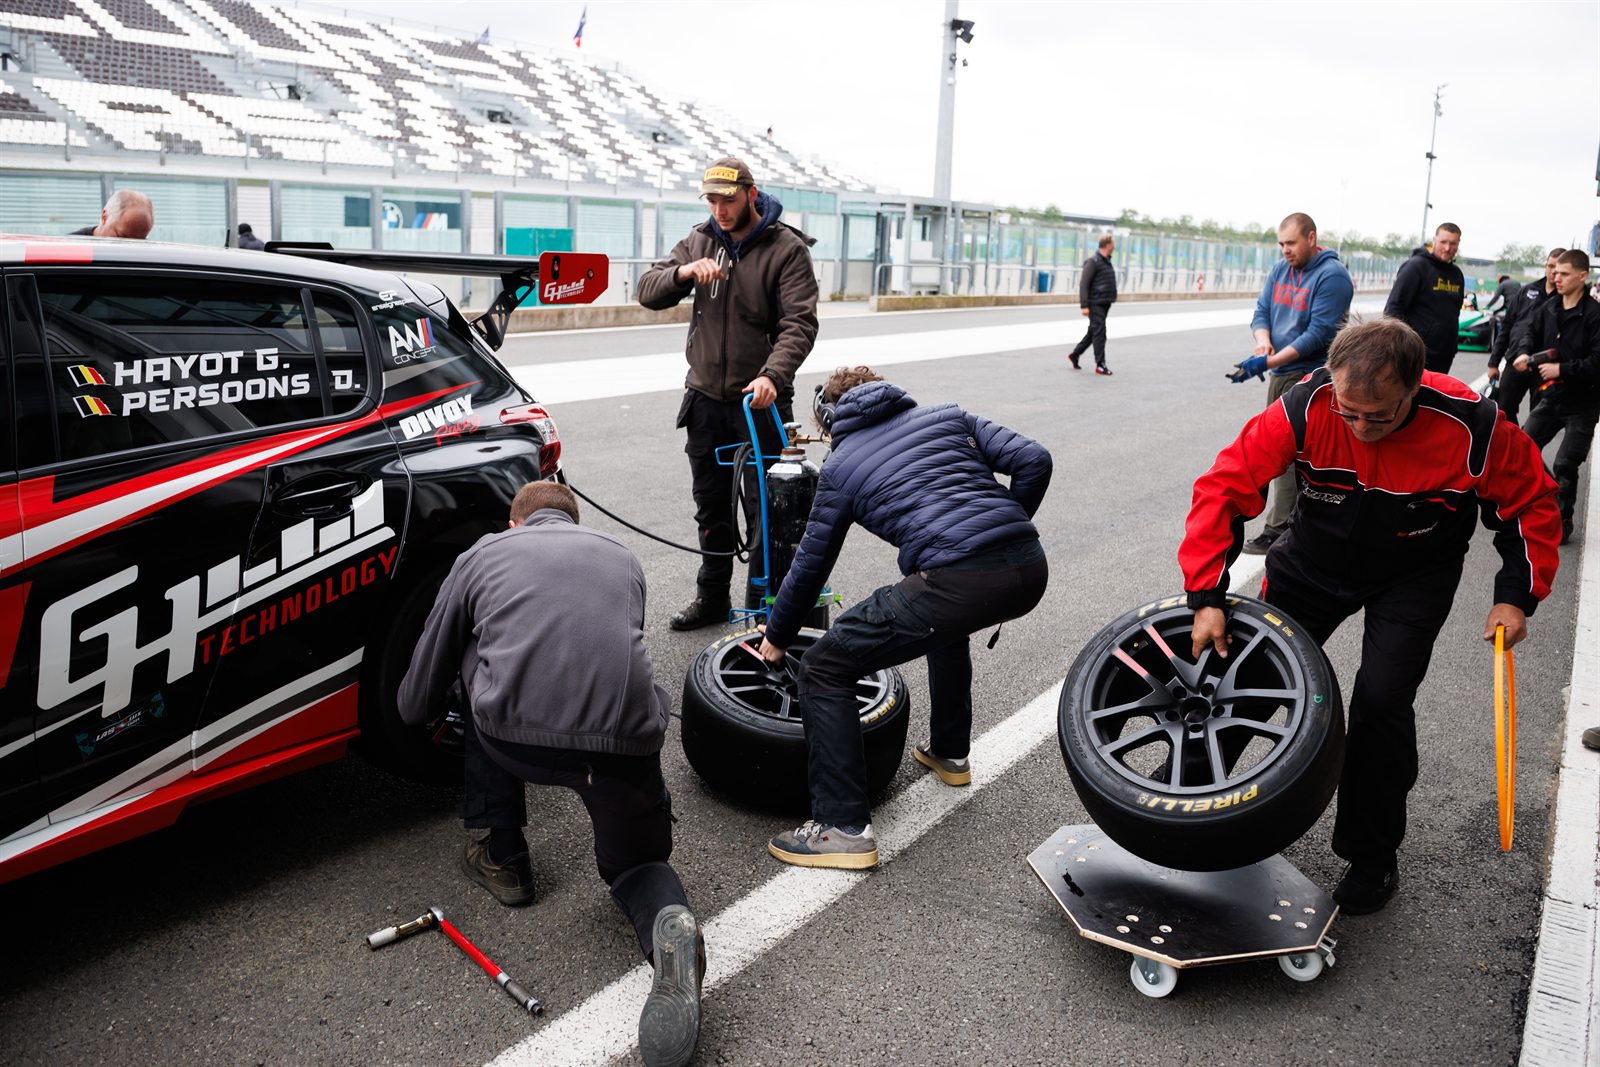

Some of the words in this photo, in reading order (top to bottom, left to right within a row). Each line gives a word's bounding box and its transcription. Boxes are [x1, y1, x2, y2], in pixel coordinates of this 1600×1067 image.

[113, 350, 244, 386] HAYOT
[254, 347, 290, 372] G.
[394, 345, 437, 365] CONCEPT
[121, 373, 310, 417] PERSOONS
[331, 369, 361, 390] D.
[399, 393, 474, 440] DIVOY
[200, 546, 398, 665] TECHNOLOGY
[1147, 783, 1259, 813] PIRELLI
